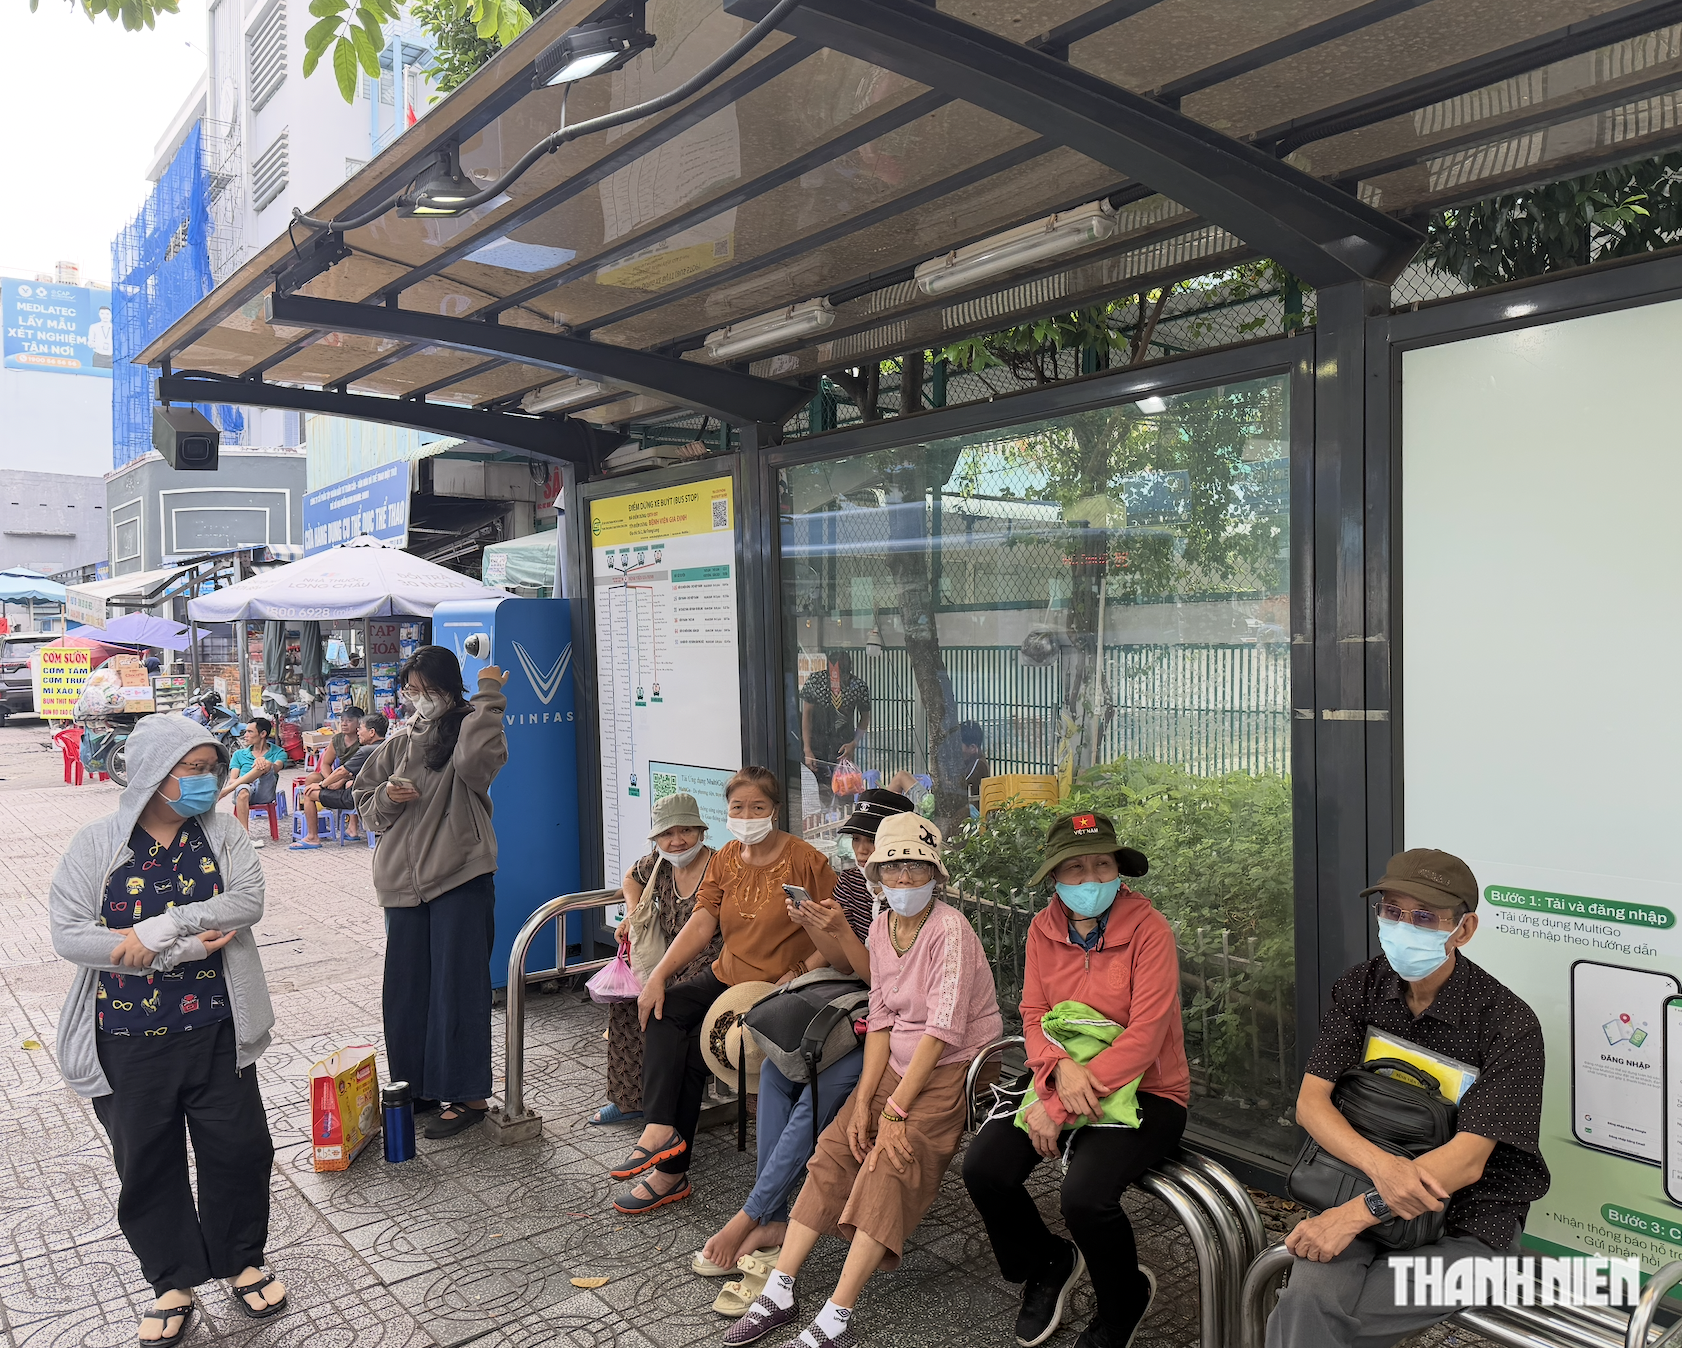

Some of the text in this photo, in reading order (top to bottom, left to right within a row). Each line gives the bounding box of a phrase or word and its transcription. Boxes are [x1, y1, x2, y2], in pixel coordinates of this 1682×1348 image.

[17, 301, 76, 316] MEDLATEC
[18, 314, 76, 331] LẤY MẪU
[7, 327, 88, 346] XÉT NGHIỆM
[22, 341, 74, 356] TẬN NƠI
[628, 502, 639, 511] ĐIỂM
[640, 500, 654, 510] DỪNG
[654, 499, 660, 508] XE
[661, 497, 672, 507] BUÝT
[674, 495, 684, 505] (BUS
[685, 493, 700, 504] STOP)
[351, 504, 362, 536] THỂ
[363, 510, 374, 533] DỤC
[375, 496, 388, 531] THỂ
[388, 500, 405, 528] THAO
[649, 518, 659, 526] BỆNH
[660, 517, 668, 525] VIỆN
[677, 514, 687, 522] ĐỊNH
[332, 581, 370, 589] CHÂU
[422, 581, 467, 589] NGÀY
[265, 606, 295, 618] 1800
[298, 607, 330, 618] 6928
[370, 625, 395, 639] TẠP
[43, 650, 88, 664] CƠM SƯỜN
[506, 711, 574, 726] VINFAS
[1491, 890, 1668, 925] Bước 1: Tải và đăng nhập
[1500, 910, 1621, 938] Tải ứng dụng MultiGo
[1500, 924, 1658, 957] Đăng nhập theo hướng dẫn
[1600, 1054, 1651, 1071] ĐĂNG NHẬP
[1608, 1208, 1682, 1240] Bước 3: C
[1553, 1212, 1584, 1229] Nhận
[1587, 1222, 1622, 1243] thông
[1624, 1232, 1647, 1250] báo
[1651, 1242, 1666, 1255] hỗ
[1584, 1235, 1660, 1268] Gửi phản hồi
